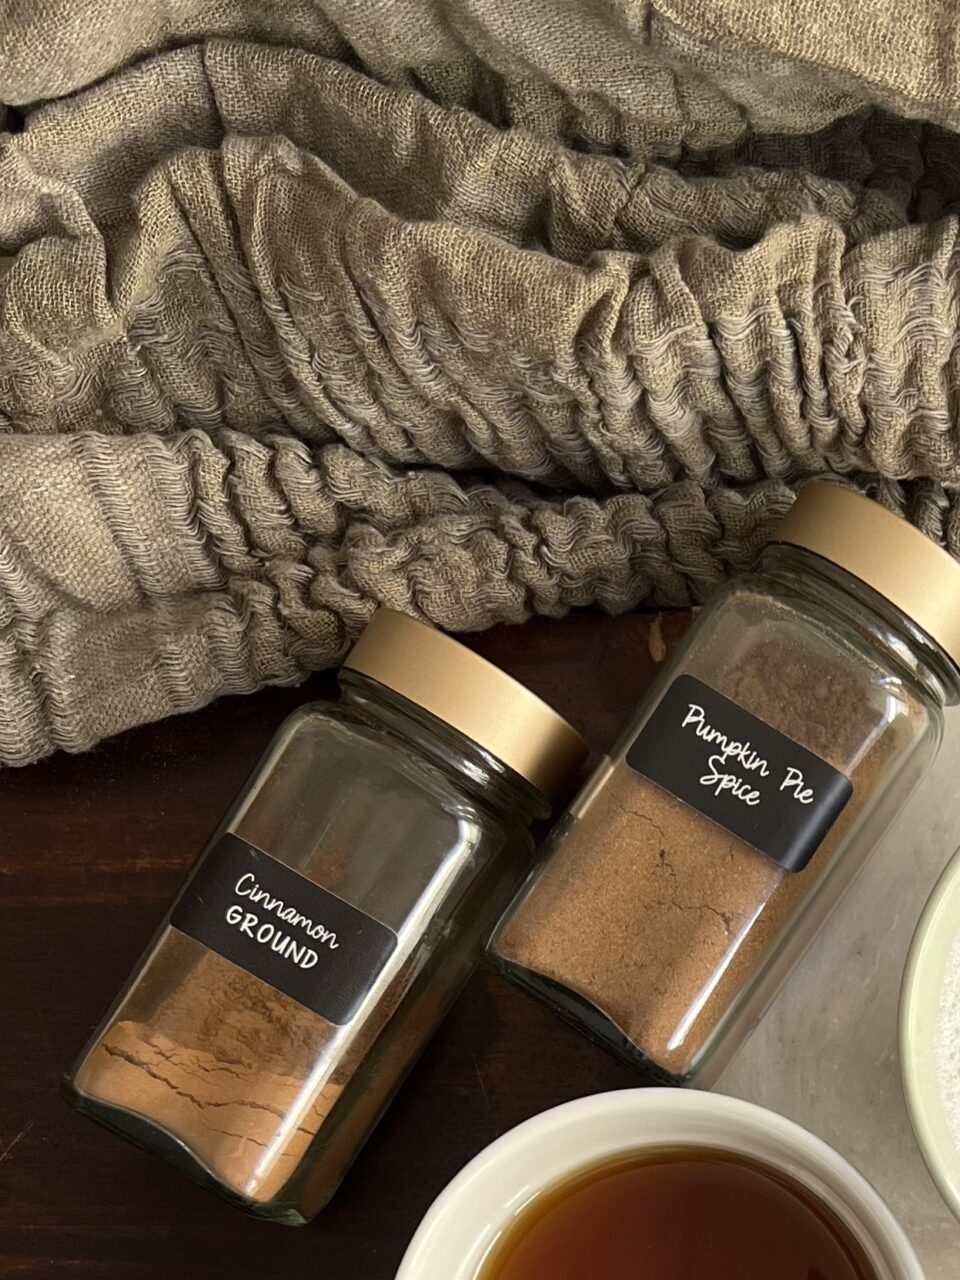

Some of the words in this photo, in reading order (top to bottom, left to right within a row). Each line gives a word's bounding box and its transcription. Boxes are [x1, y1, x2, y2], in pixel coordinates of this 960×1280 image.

[681, 703, 769, 777] Pumpkin
[779, 767, 814, 804] Pie
[699, 754, 761, 806] Spice
[226, 905, 319, 969] GROUND
[234, 872, 340, 950] Cinnamon
